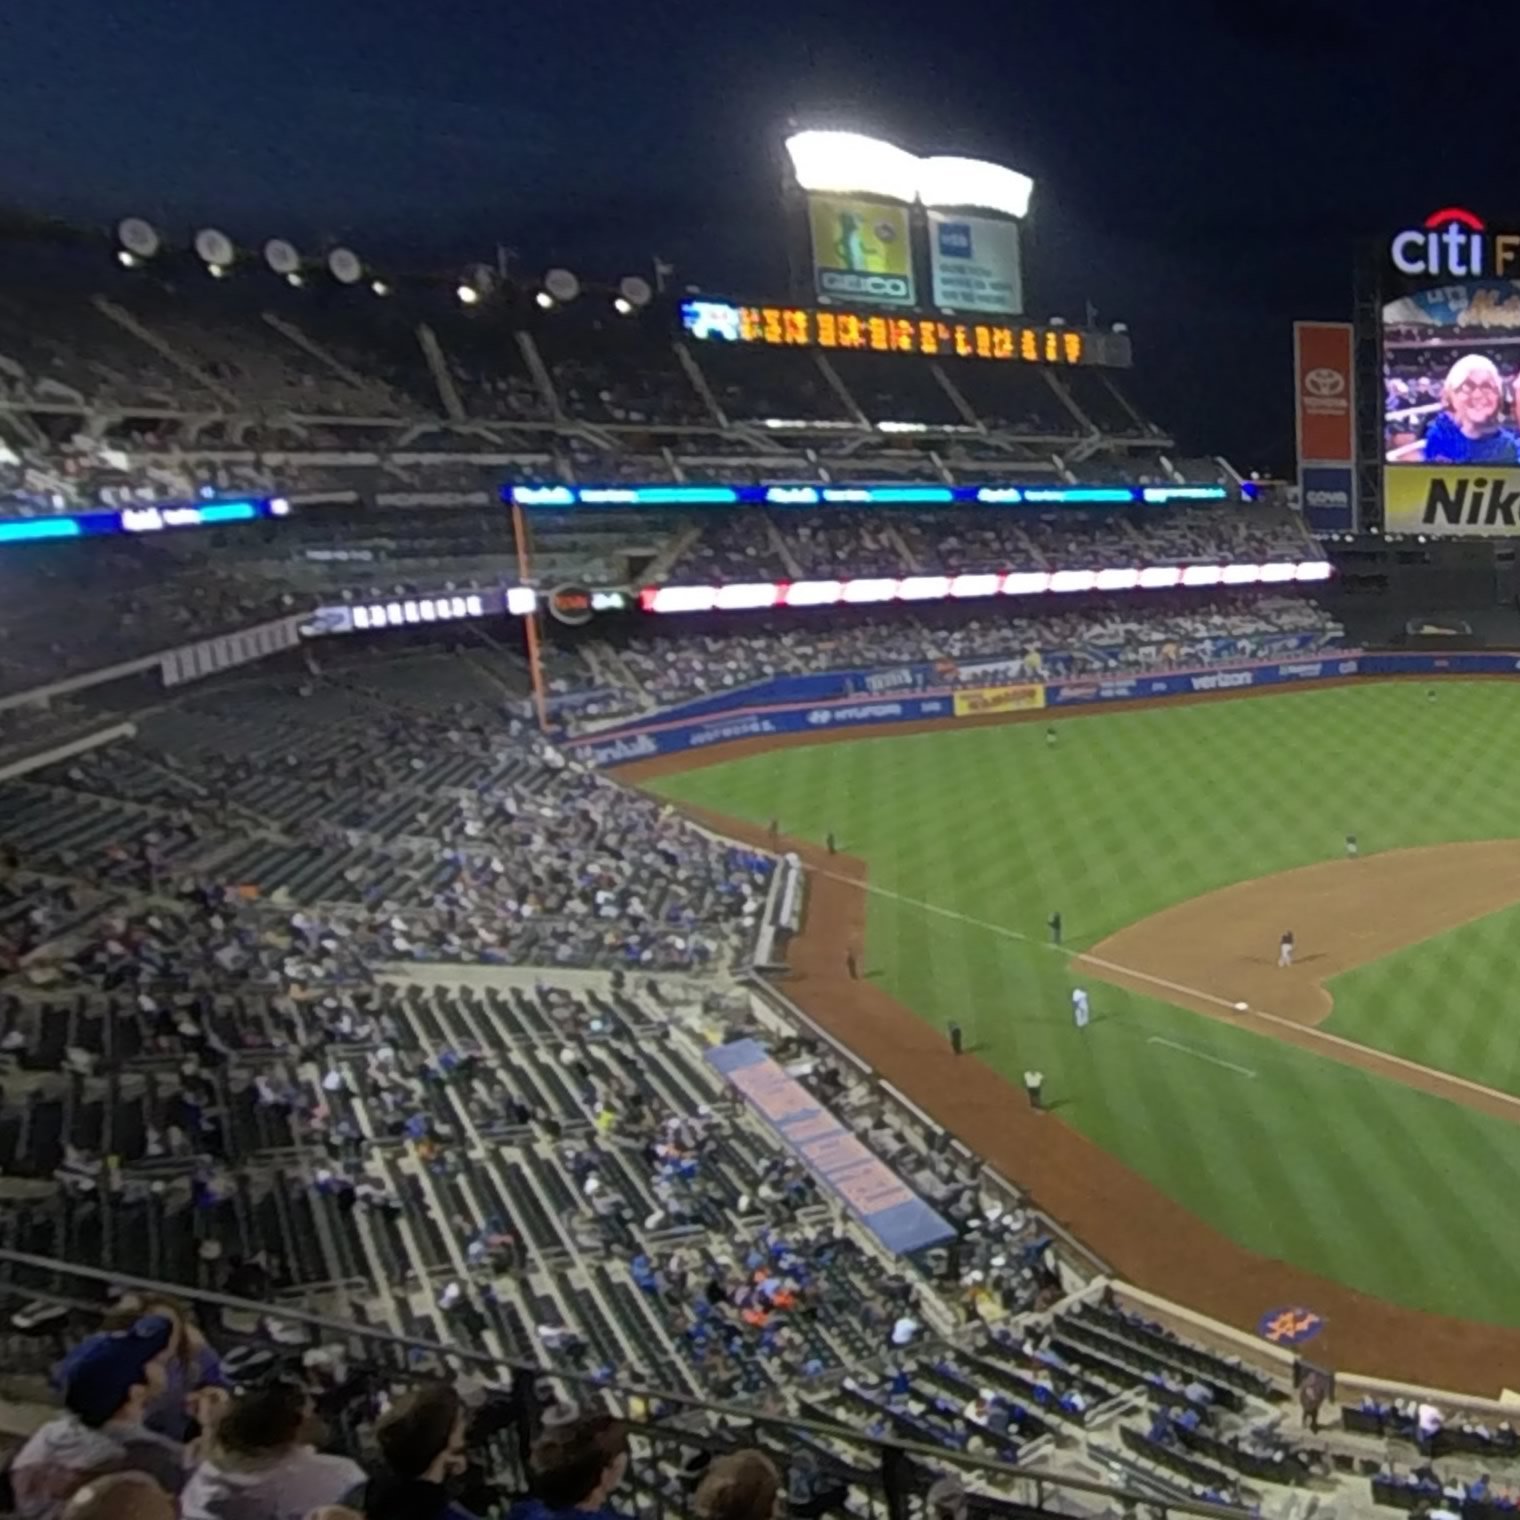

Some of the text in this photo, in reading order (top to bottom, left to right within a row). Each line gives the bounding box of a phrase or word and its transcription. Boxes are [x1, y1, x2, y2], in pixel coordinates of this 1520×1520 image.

[1391, 222, 1482, 276] citi
[822, 275, 907, 297] GEICO
[1190, 671, 1253, 690] verizon
